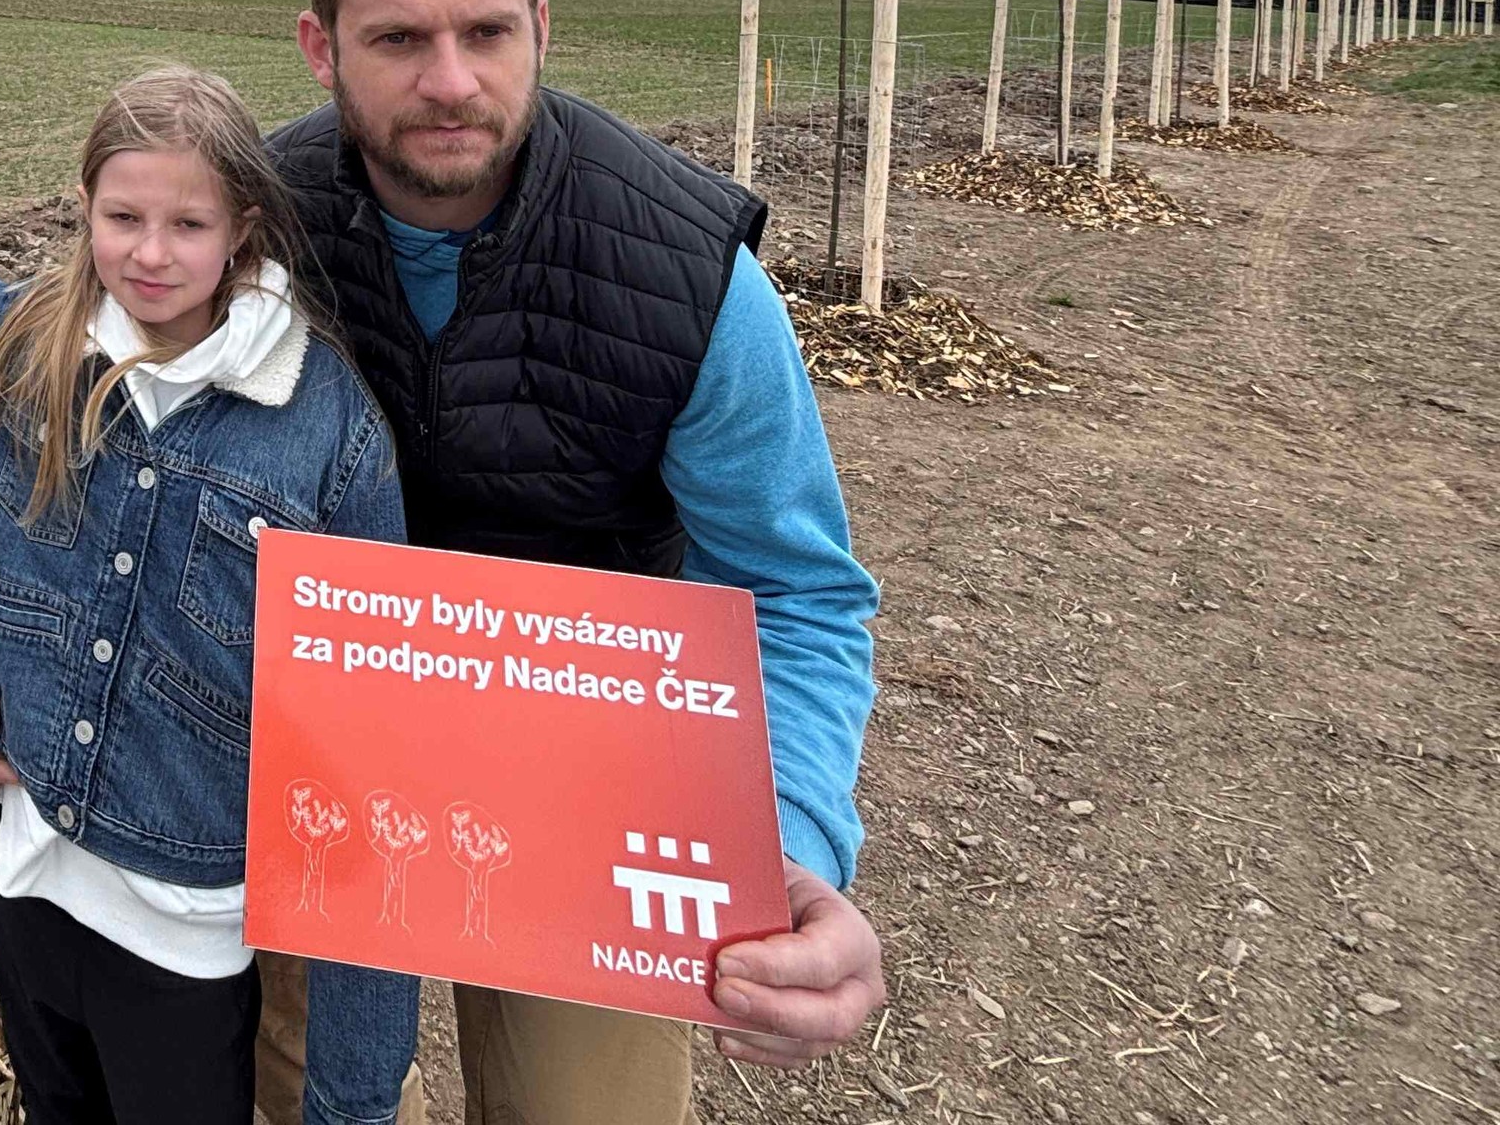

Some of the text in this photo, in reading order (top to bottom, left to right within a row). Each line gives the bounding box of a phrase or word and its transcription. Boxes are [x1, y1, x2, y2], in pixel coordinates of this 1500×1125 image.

[292, 574, 685, 663] Stromy byly vysázeny
[292, 633, 740, 720] za podpory Nadace ČEZ
[591, 940, 707, 987] NADACE
